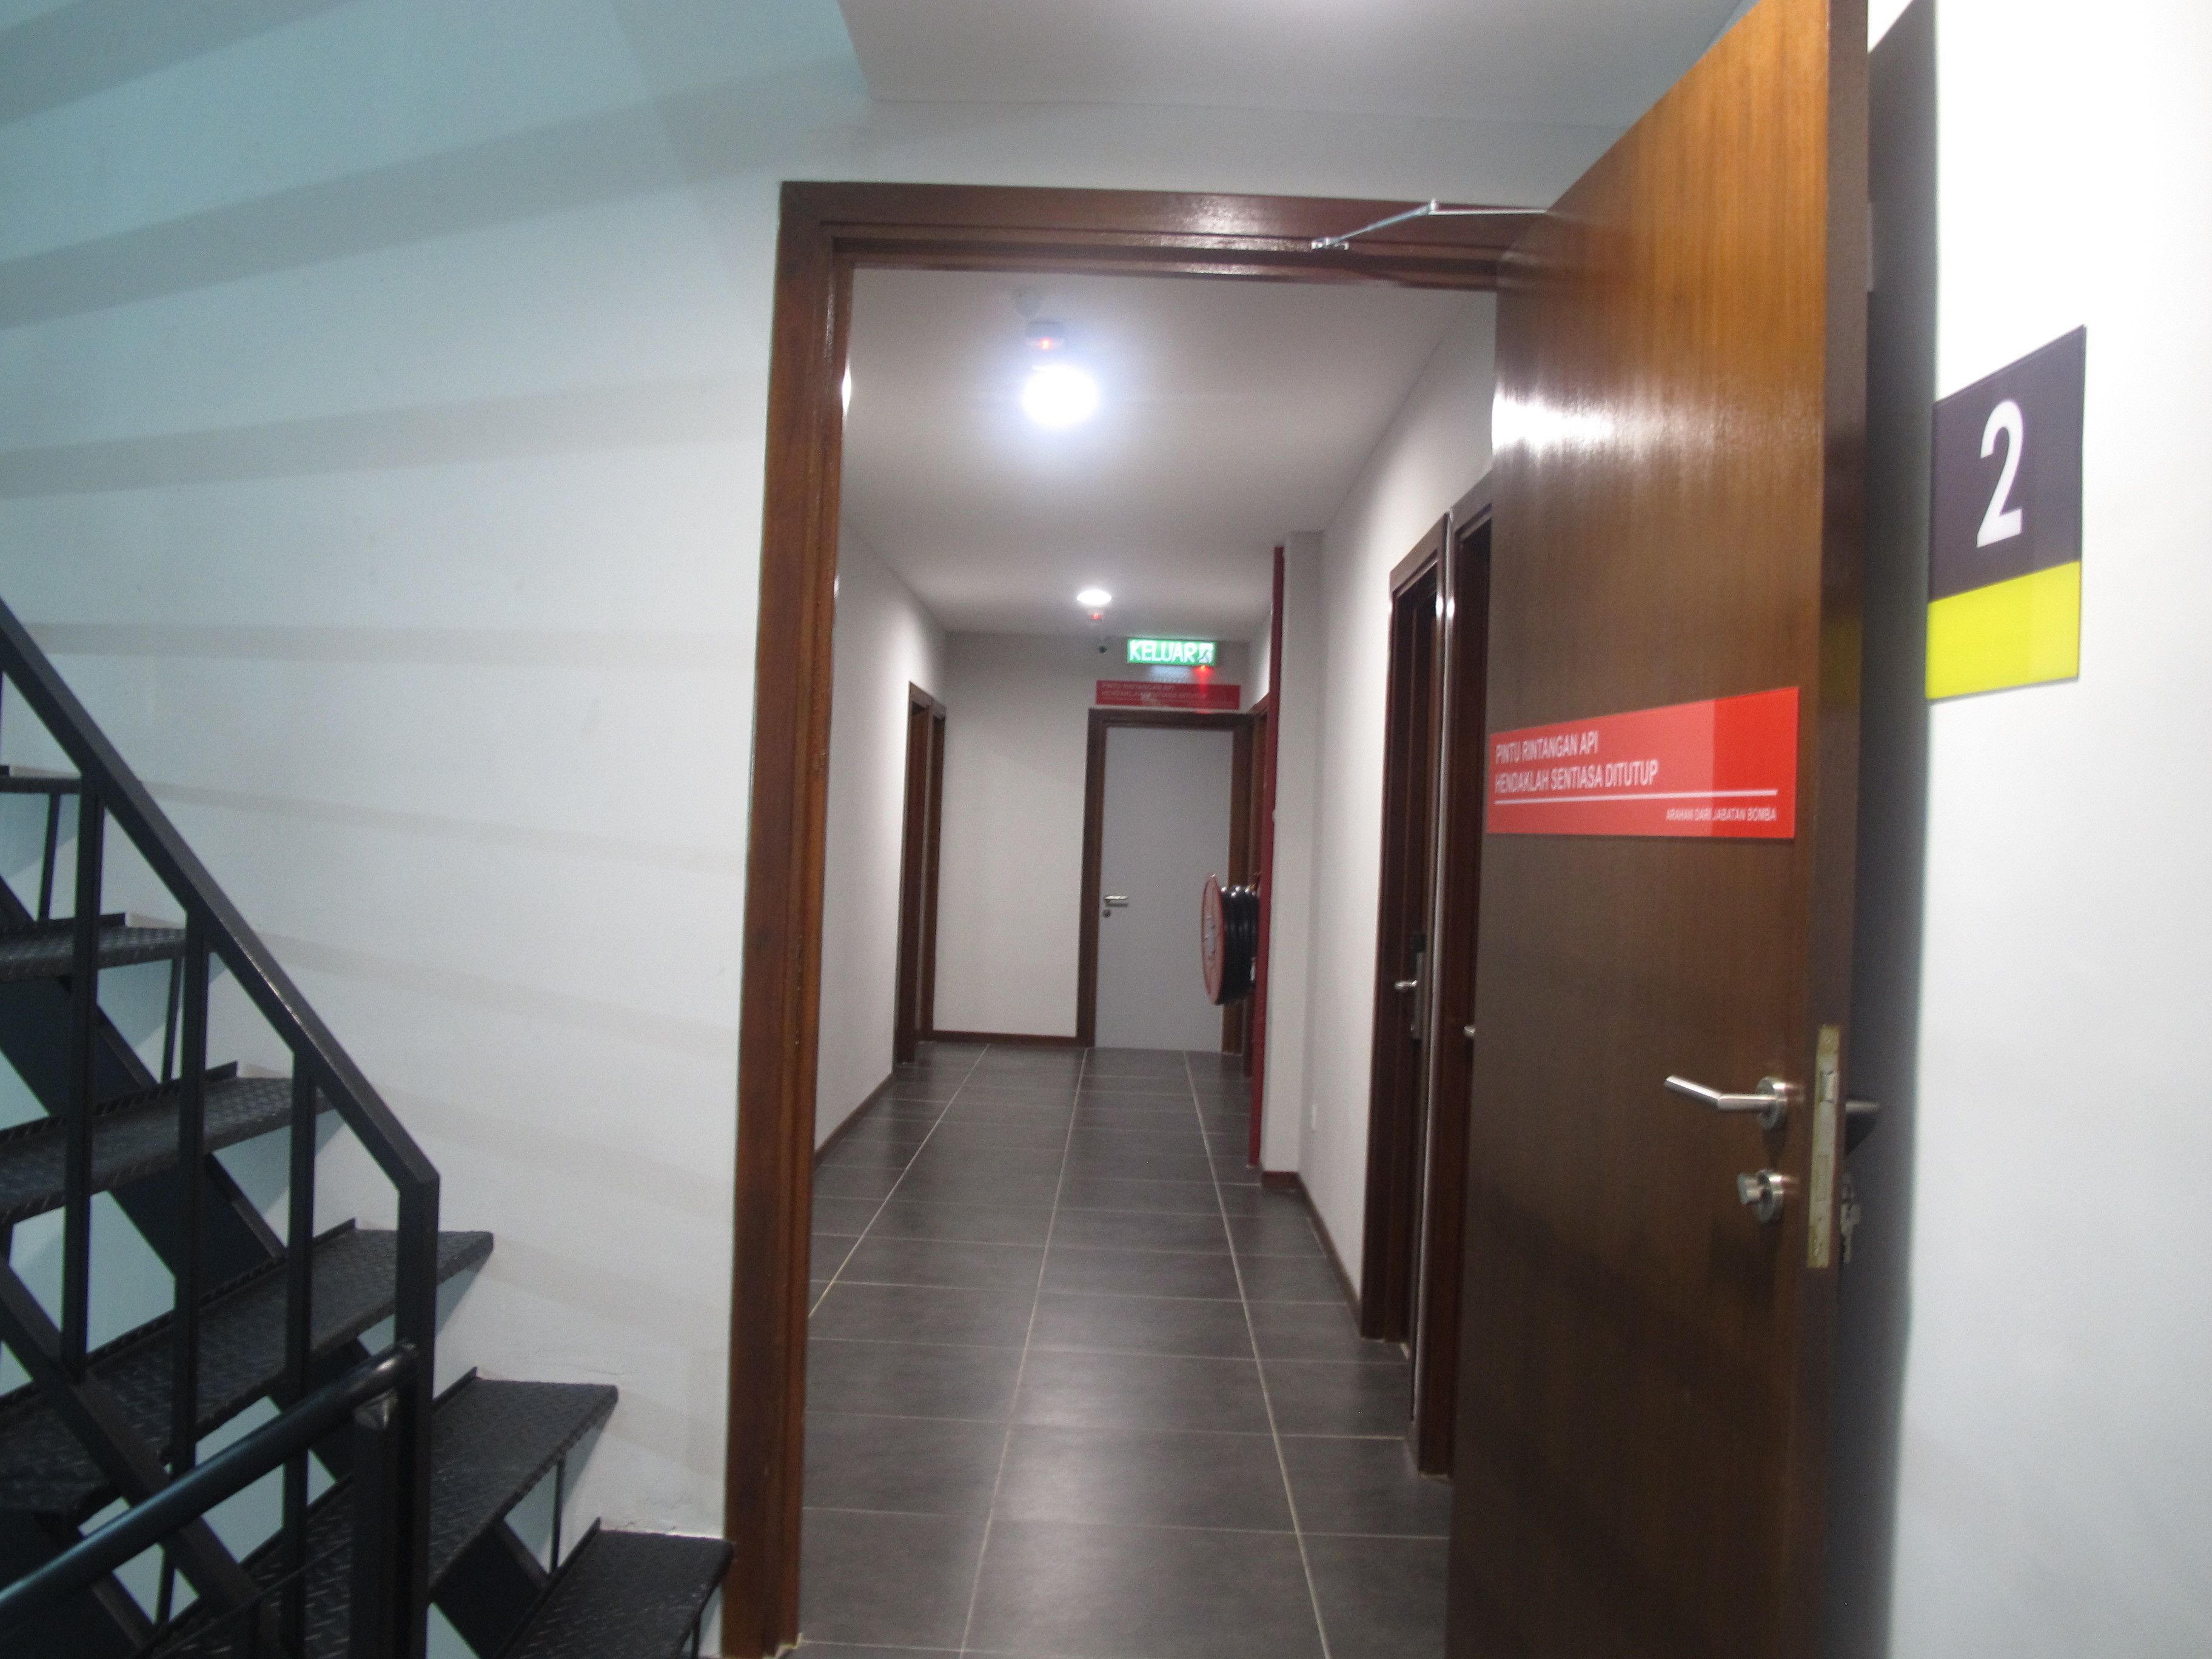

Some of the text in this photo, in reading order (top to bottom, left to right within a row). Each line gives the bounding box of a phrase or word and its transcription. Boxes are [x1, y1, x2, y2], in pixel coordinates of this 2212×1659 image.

[1977, 400, 2023, 548] 2
[1129, 640, 1196, 663] KELUAR
[1495, 731, 1598, 765] PINTU RINTANGAN API
[1495, 760, 1659, 794] HENDAKLAH SENTIASA DITUTUP
[1746, 807, 1777, 822] BOMBA
